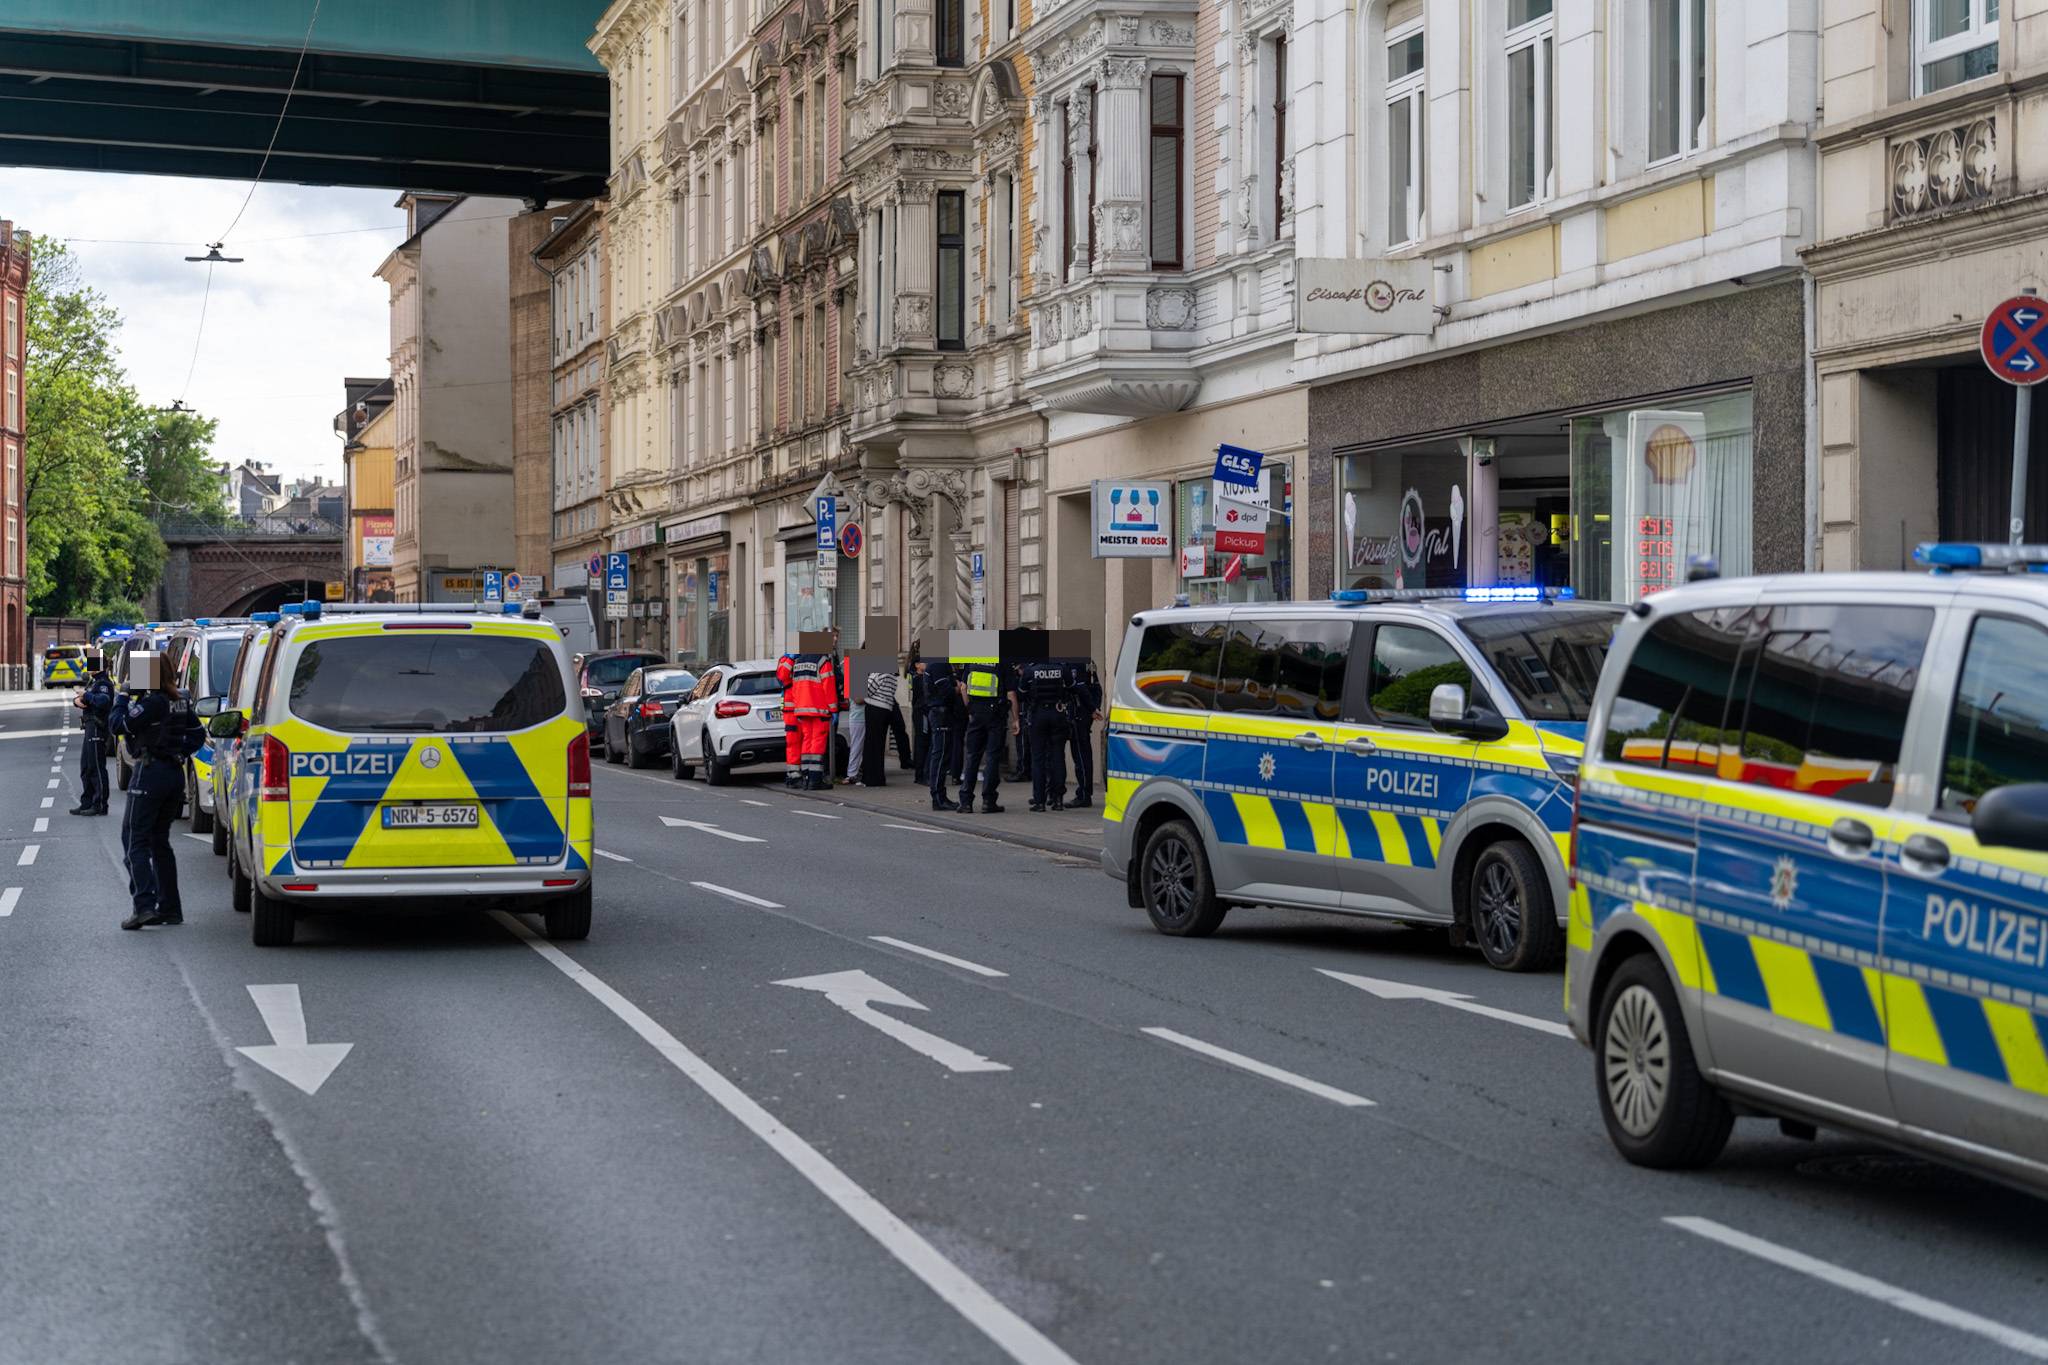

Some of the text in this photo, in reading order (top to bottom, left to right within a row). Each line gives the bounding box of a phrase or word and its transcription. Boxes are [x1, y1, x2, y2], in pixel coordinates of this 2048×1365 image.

[1306, 287, 1425, 304] Eiscafé Tal
[1221, 454, 1250, 471] GLS
[819, 500, 828, 521] P
[1241, 512, 1258, 523] dpd
[1100, 535, 1168, 546] MEISTER KIOSK
[1224, 535, 1258, 549] Pickup
[1355, 526, 1450, 568] Eiscafé Tal
[610, 555, 621, 570] P
[487, 573, 495, 585] P
[1034, 669, 1062, 679] POLIZEI
[291, 753, 394, 776] POLIZEI
[1366, 768, 1439, 799] POLIZEI
[390, 806, 477, 826] NRW 5-6576
[1922, 893, 2048, 968] POLIZEI
